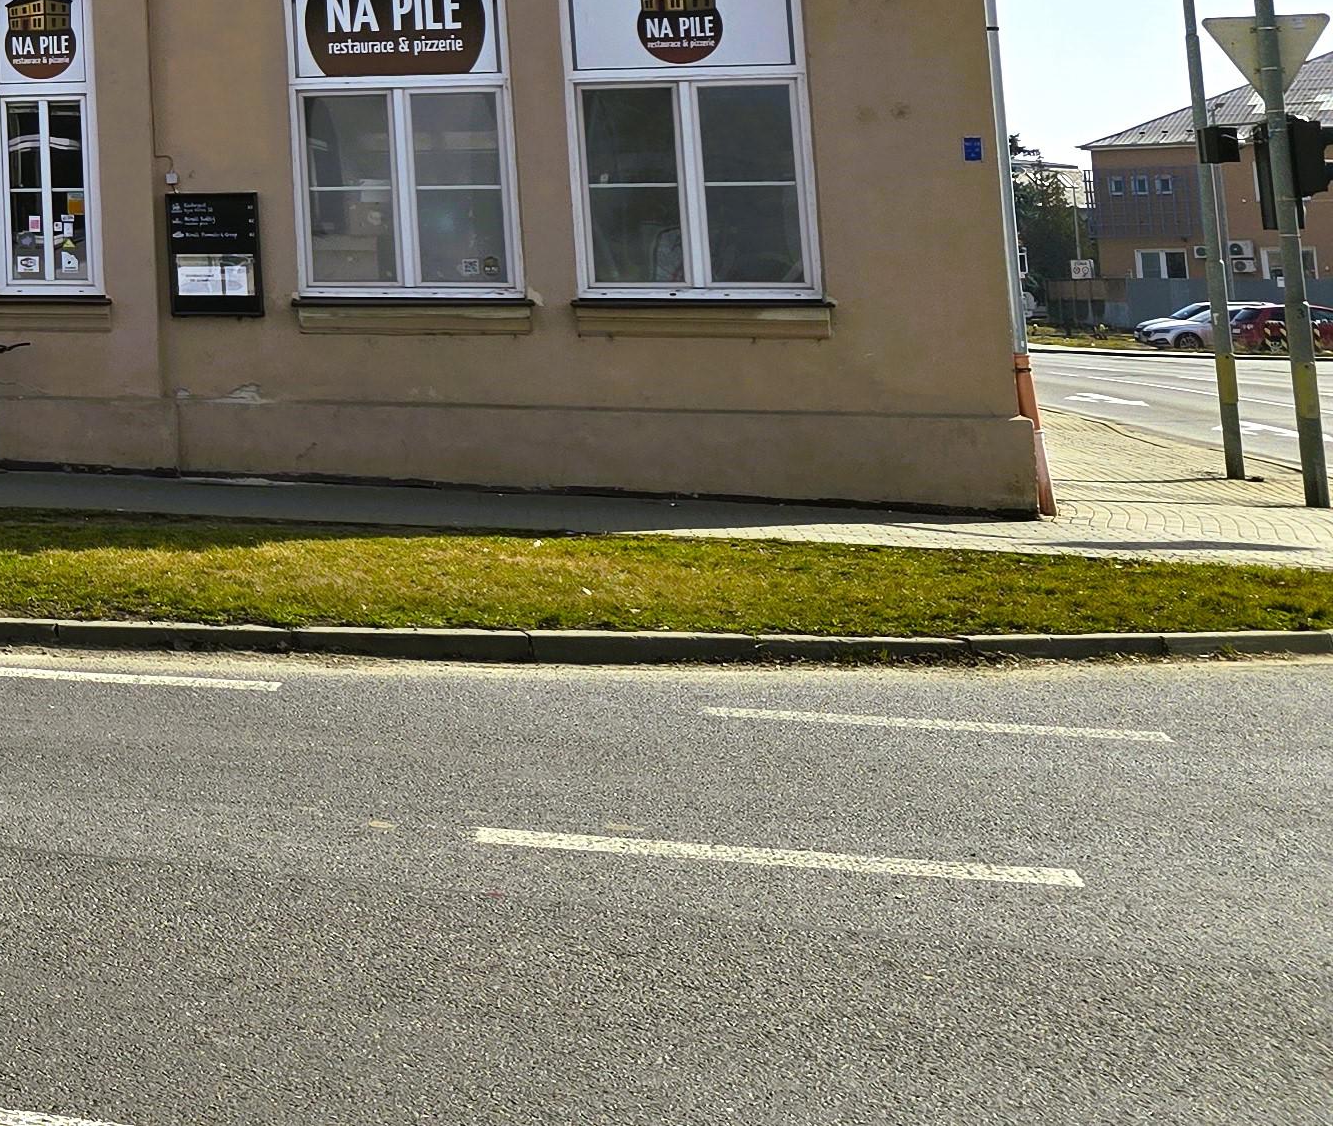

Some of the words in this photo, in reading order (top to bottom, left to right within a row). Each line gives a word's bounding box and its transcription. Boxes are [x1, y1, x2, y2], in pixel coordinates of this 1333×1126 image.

[645, 17, 674, 38] NA
[678, 16, 715, 37] PILE
[11, 36, 35, 55] NA
[39, 35, 70, 55] PILE
[328, 38, 395, 54] restaurace
[398, 36, 410, 53] &
[414, 34, 464, 56] pizzerie
